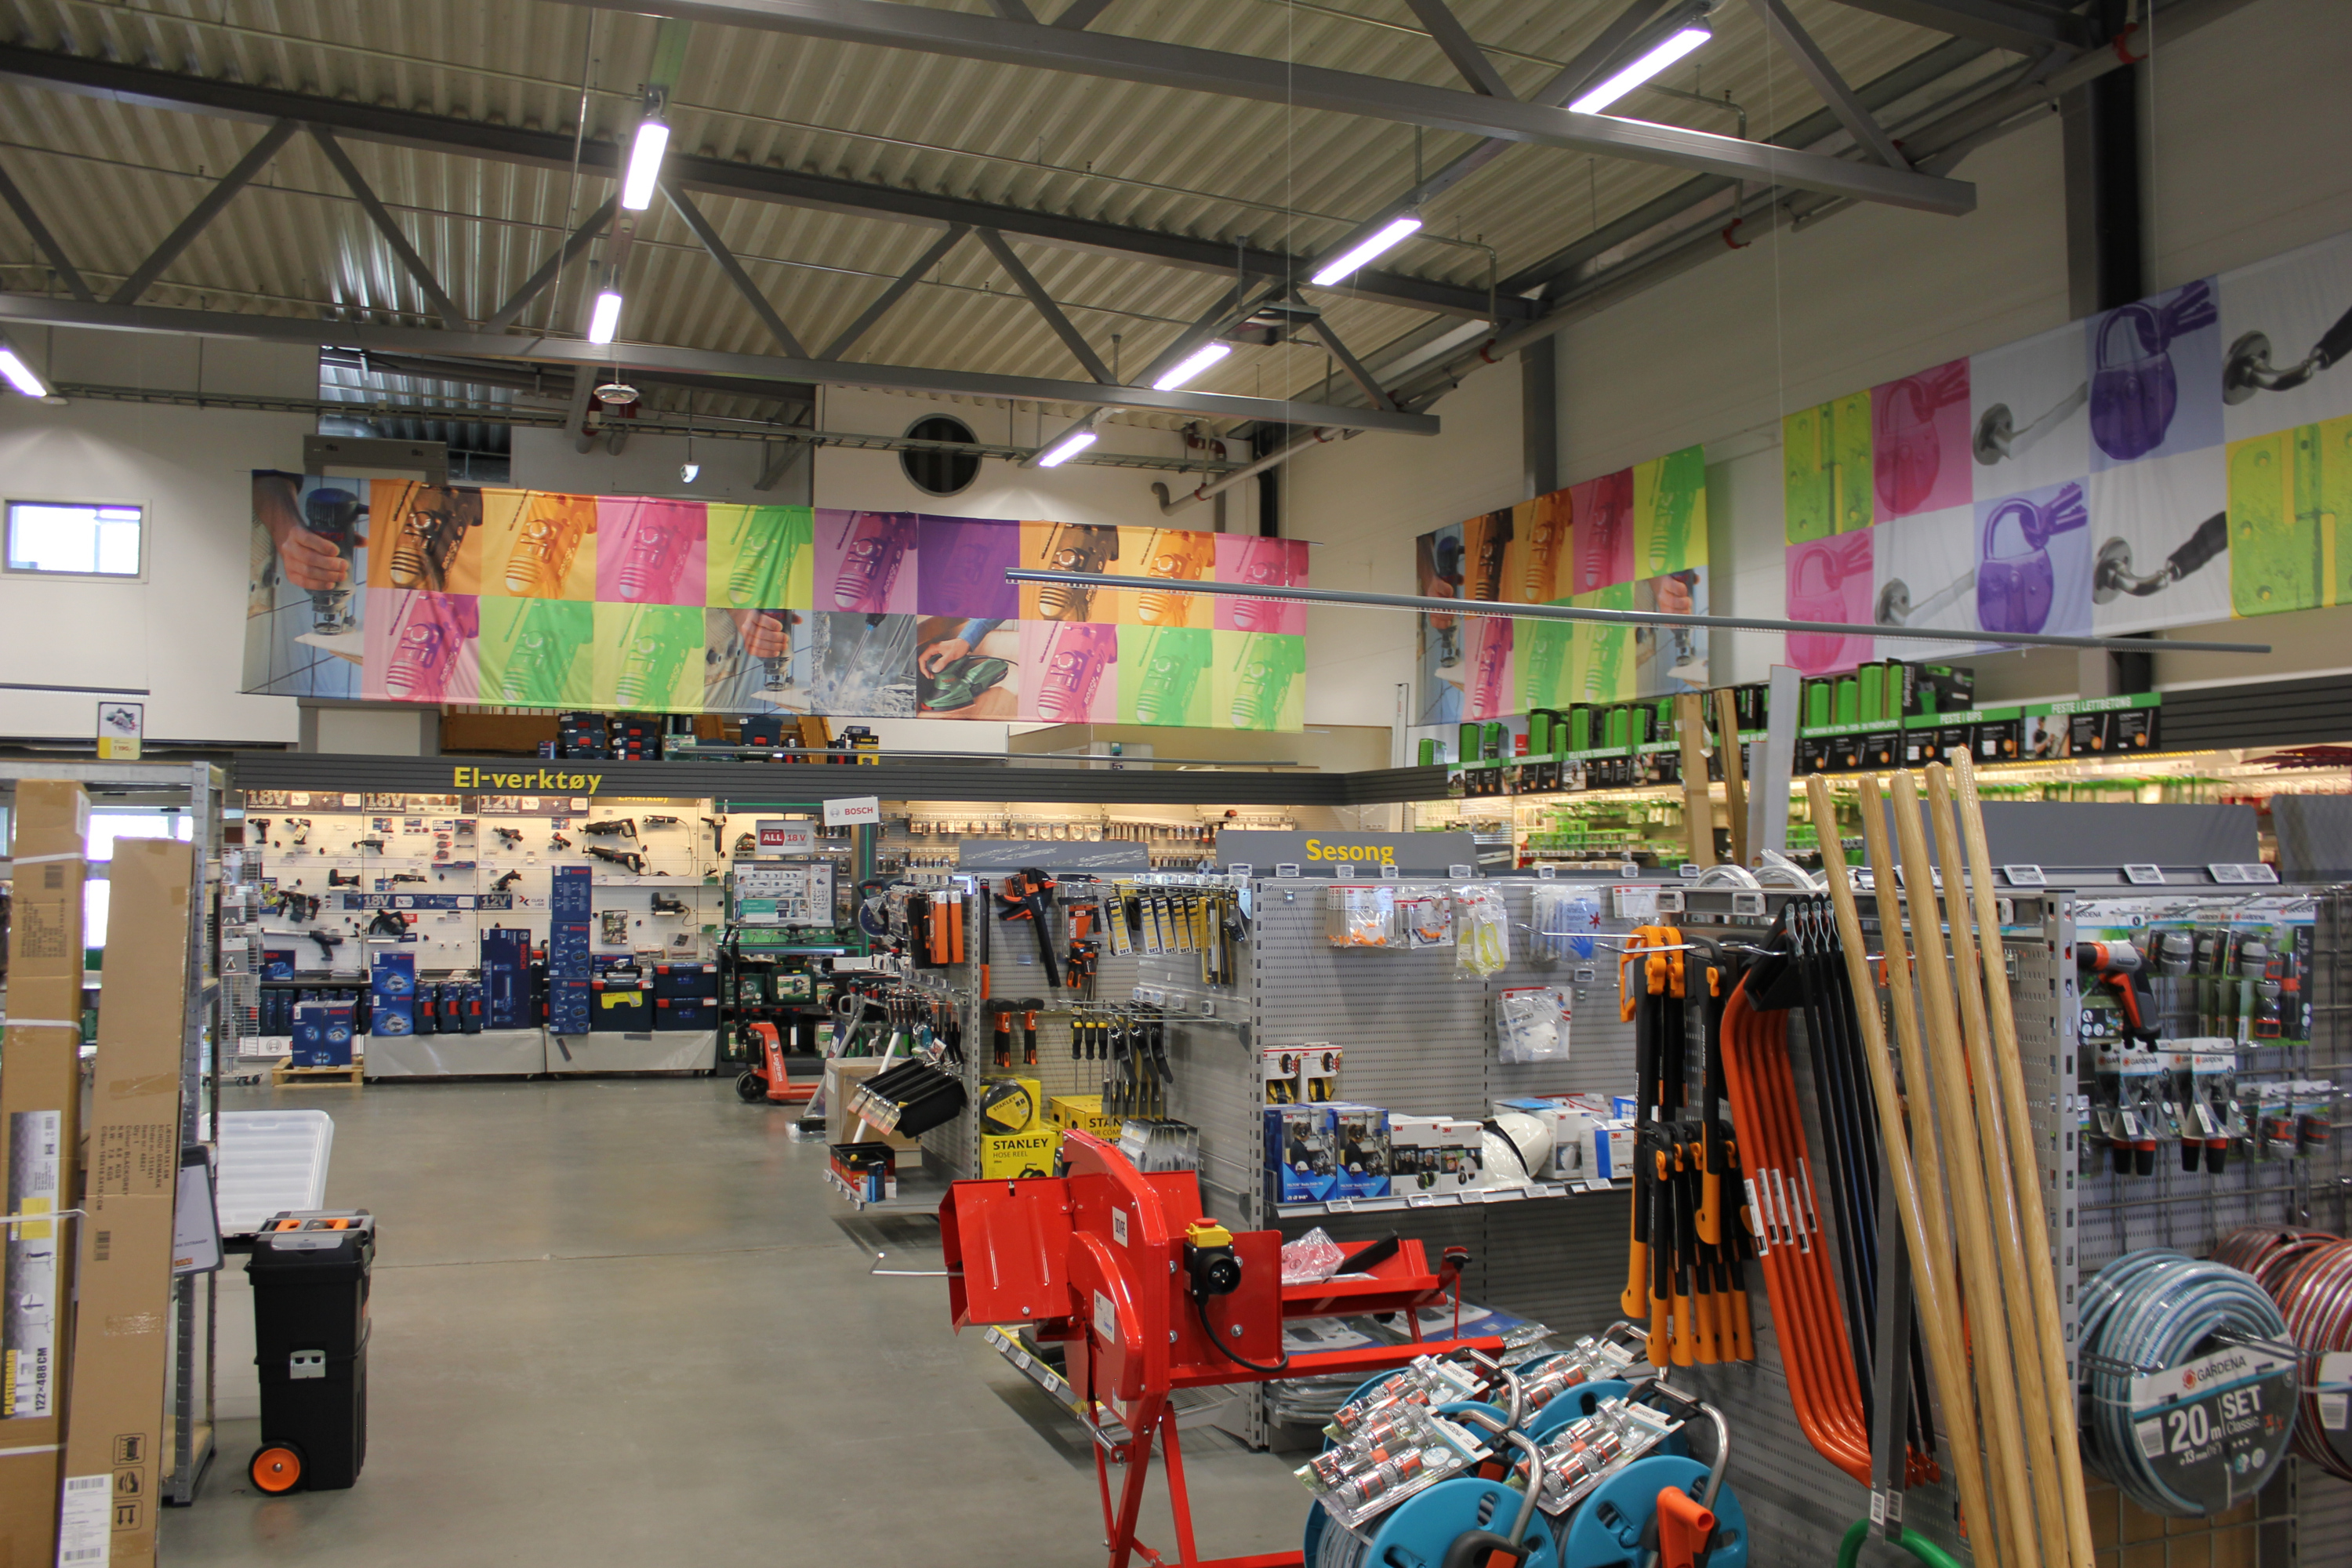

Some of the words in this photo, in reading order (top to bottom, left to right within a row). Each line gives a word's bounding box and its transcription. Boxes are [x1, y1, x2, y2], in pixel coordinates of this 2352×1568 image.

[454, 767, 602, 794] El-verktøy
[248, 790, 288, 805] 18V
[365, 793, 405, 808] 18V
[844, 807, 873, 815] BOSCH
[1305, 839, 1395, 866] Sesong
[364, 895, 390, 907] 18V
[482, 895, 509, 907] 12V
[773, 1053, 783, 1082] Logitrans
[993, 1096, 1017, 1112] STANLEY
[1089, 1117, 1122, 1127] STAN
[993, 1138, 1049, 1150] STANLEY
[122, 1151, 131, 1196] BLACK/GREY
[1447, 1365, 1464, 1379] GARDENA
[2198, 1356, 2247, 1382] GARDENA
[3, 1349, 17, 1415] PLASTERBOARD
[15, 1349, 37, 1412] LIFT
[2168, 1403, 2209, 1453] 20
[2210, 1425, 2223, 1441] m
[2222, 1384, 2261, 1421] SET
[2227, 1416, 2260, 1435] Classic
[1443, 1420, 1464, 1439] GARDENA
